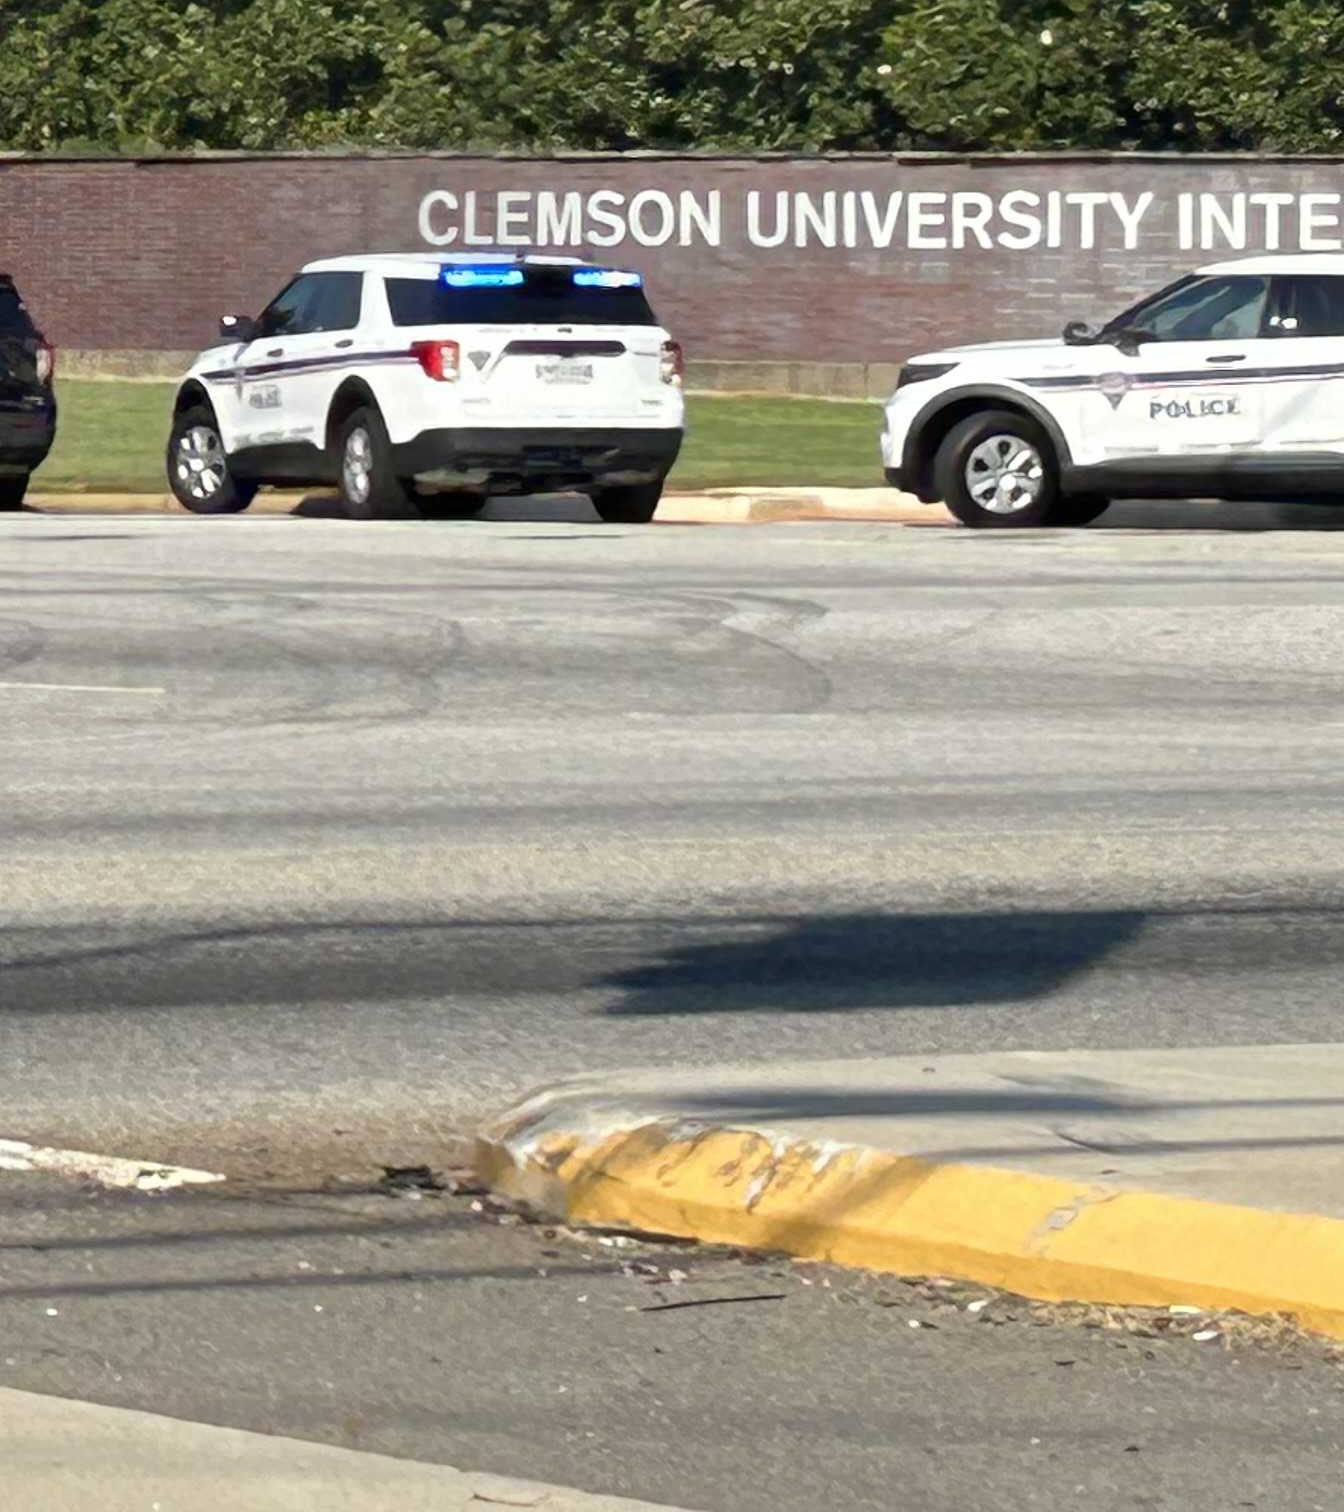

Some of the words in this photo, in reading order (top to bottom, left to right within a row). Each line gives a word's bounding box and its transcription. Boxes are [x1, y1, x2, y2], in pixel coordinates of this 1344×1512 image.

[417, 189, 722, 247] CLEMSON
[746, 189, 1154, 249] UNIVERSITY
[1177, 191, 1343, 250] INTE
[1149, 397, 1241, 420] POLICE
